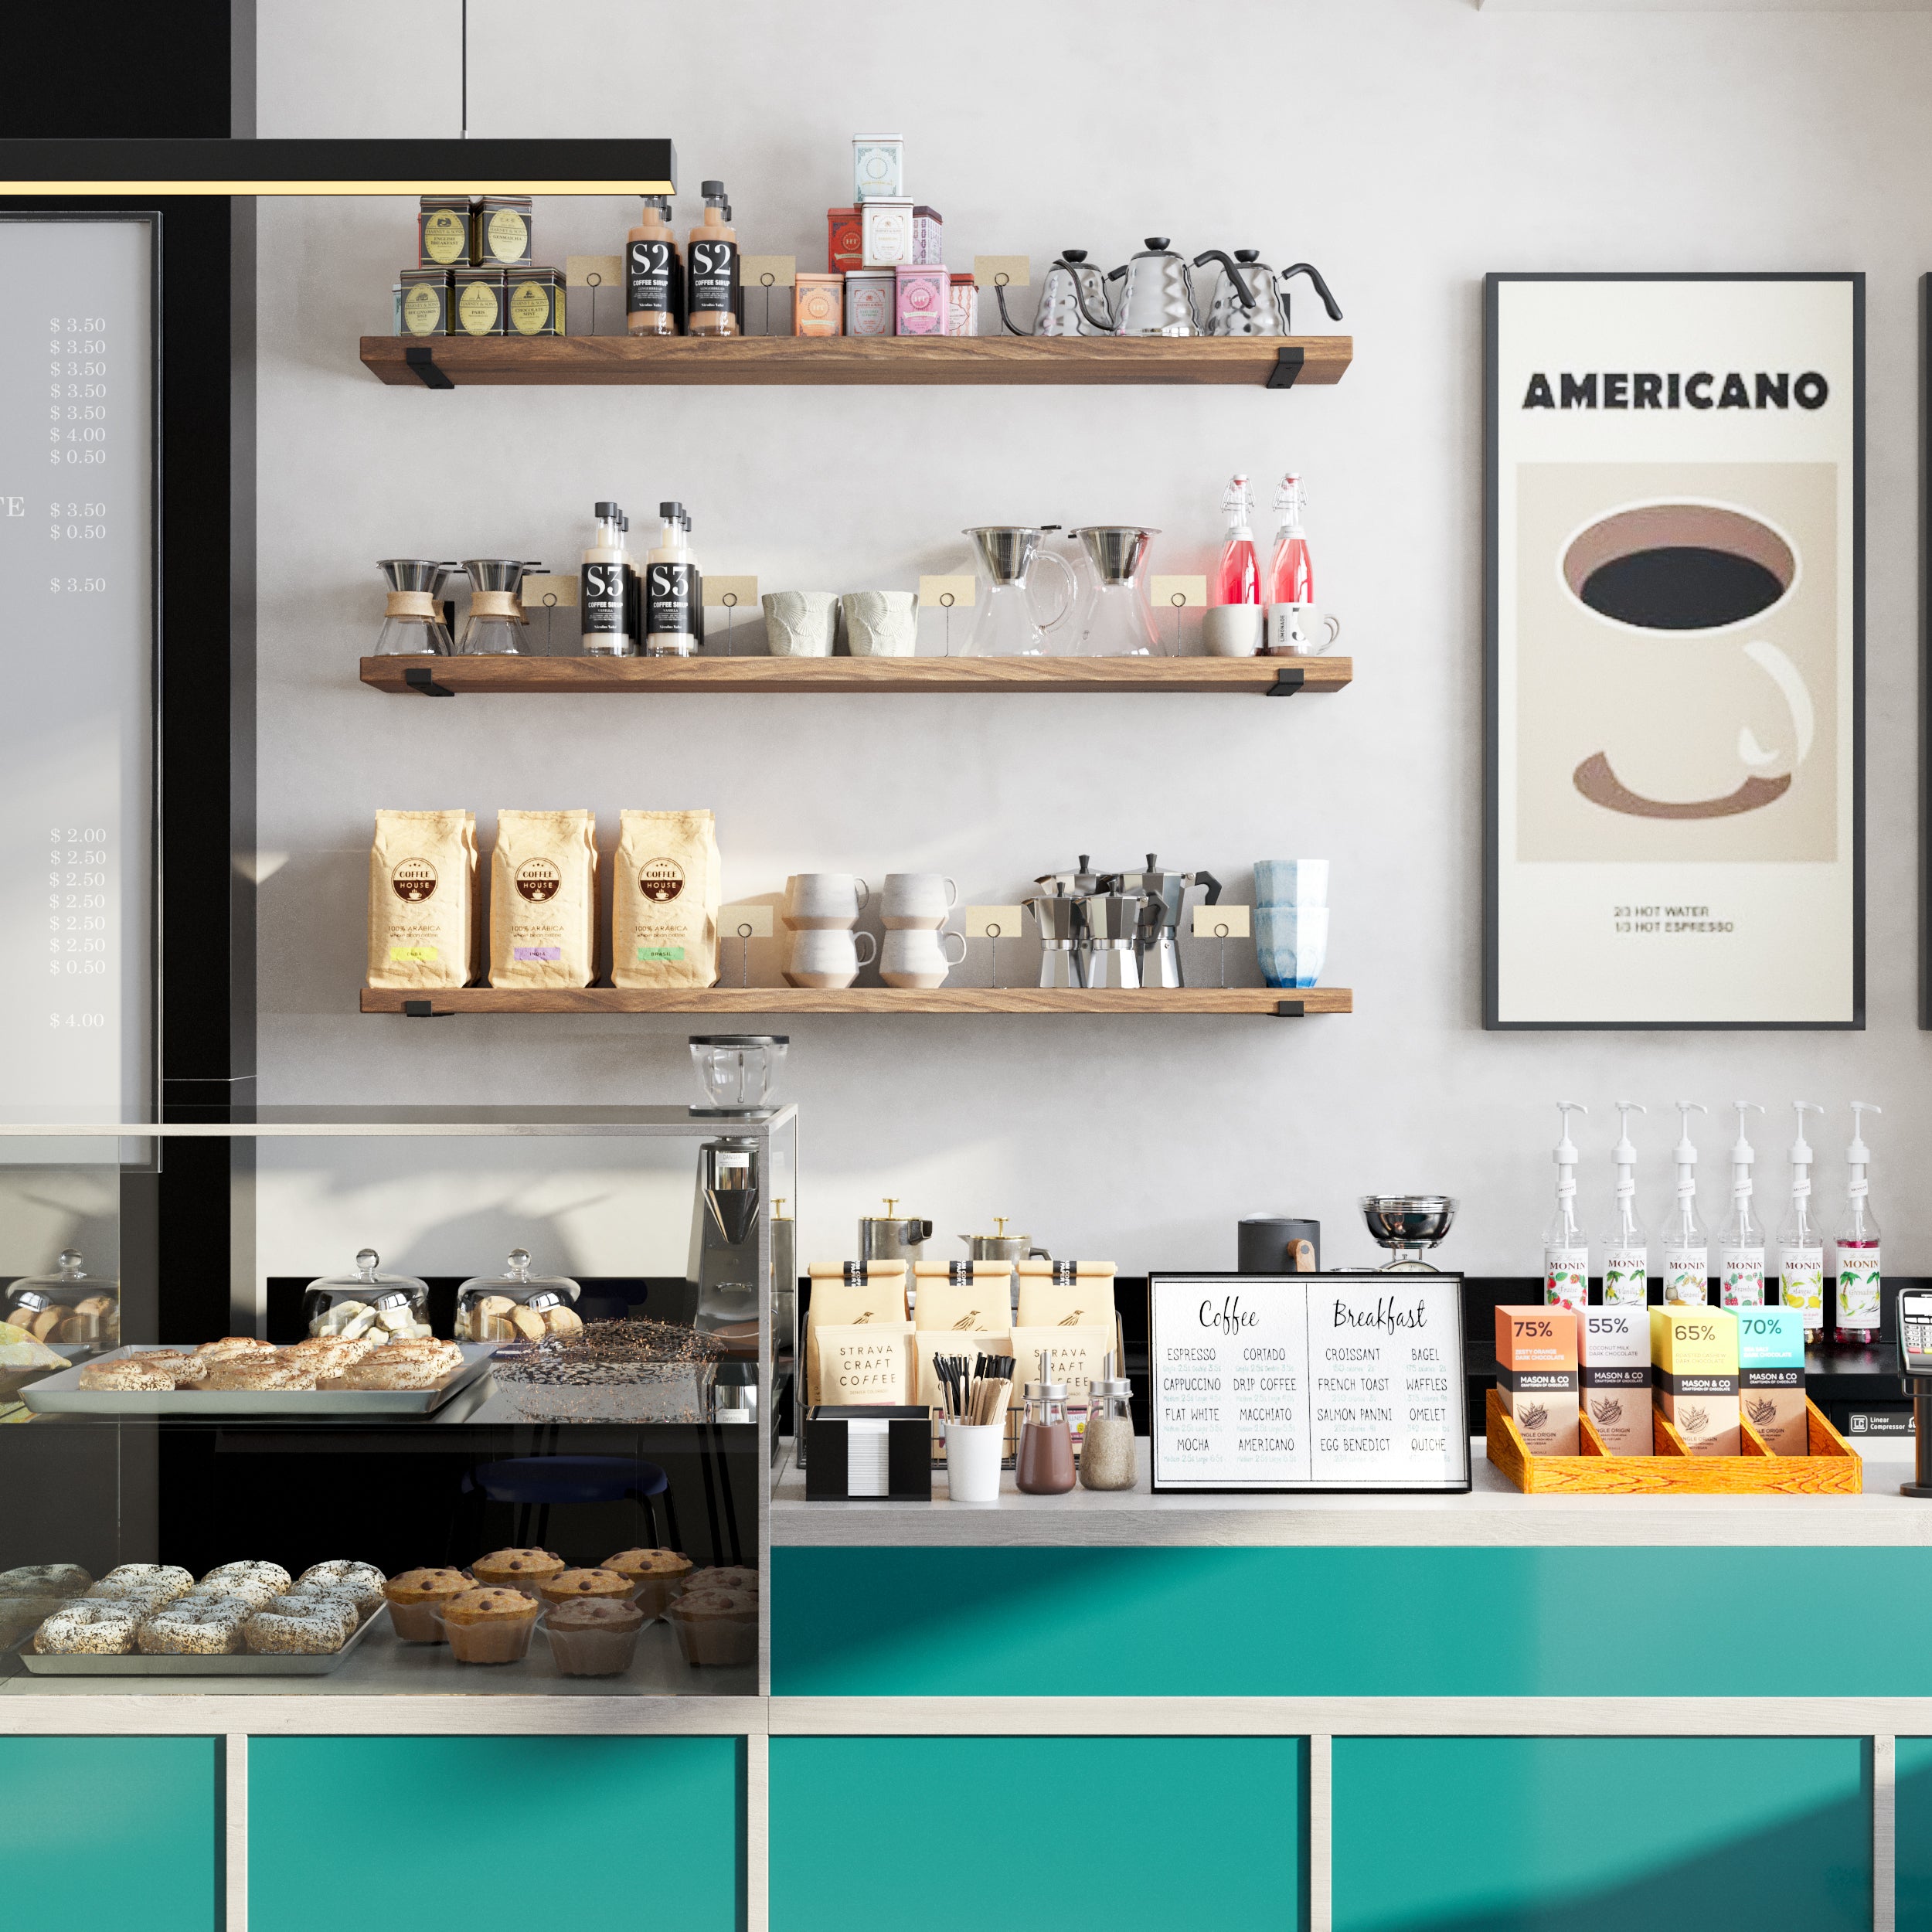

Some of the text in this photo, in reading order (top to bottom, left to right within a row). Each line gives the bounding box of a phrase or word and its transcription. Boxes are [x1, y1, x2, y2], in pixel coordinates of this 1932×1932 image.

[631, 243, 668, 275] S2
[694, 243, 730, 275] S2
[66, 318, 106, 332] 3.50
[66, 340, 106, 354] 3.50
[66, 362, 106, 376] 3.50
[66, 384, 106, 397] 3.50
[1522, 372, 1829, 410] AMERICANO
[66, 406, 106, 420] 3.50
[66, 428, 106, 442] 4.00
[66, 450, 106, 464] 0.50
[66, 503, 106, 516] 3.50
[66, 526, 106, 539] 0.50
[66, 578, 106, 592] 3.50
[587, 566, 623, 597] S3
[652, 566, 689, 597] S3
[67, 828, 106, 842] 2.00
[67, 851, 106, 864] 2.50
[66, 872, 105, 886] 2.50
[66, 895, 105, 908] 2.50
[1635, 906, 1660, 917] HOT
[1665, 906, 1709, 917] WATER
[66, 917, 105, 930] 2.50
[1635, 922, 1660, 932] HOT
[1665, 922, 1733, 932] ESPRESSO
[66, 939, 105, 952] 2.50
[66, 961, 105, 974] 0.50
[65, 1014, 104, 1027] 4.00
[1199, 1296, 1260, 1335] Coffee
[1333, 1296, 1427, 1335] Breakfast
[1514, 1321, 1552, 1337] 75%
[1589, 1318, 1628, 1333] 55%
[1742, 1320, 1781, 1334] 70%
[1675, 1326, 1716, 1340] 65%
[840, 1345, 893, 1355] STRAVA
[1168, 1348, 1216, 1360] ESPRESSO
[1244, 1348, 1286, 1360] CORTADO
[1326, 1348, 1380, 1360] CROISSANT
[1412, 1348, 1440, 1360] BAGEL
[844, 1359, 890, 1369] CRAFT
[840, 1374, 896, 1386] COFFEE
[1164, 1379, 1221, 1391] CAPPUCCINO
[1233, 1379, 1297, 1391] DRIP COFFEE
[1318, 1379, 1389, 1391] FRENCH TOAST
[1406, 1379, 1447, 1391] WAFFLES
[1165, 1408, 1219, 1420] FLAT WHITE
[1240, 1408, 1292, 1420] MACCHIATO
[1317, 1408, 1393, 1420] SALMON PANINI
[1410, 1408, 1445, 1420] OMELET
[1178, 1438, 1209, 1451] MOCHA
[1239, 1438, 1294, 1451] AMERICANO
[1321, 1438, 1389, 1451] EGG BENEDICT
[1411, 1438, 1446, 1451] QUICHE
